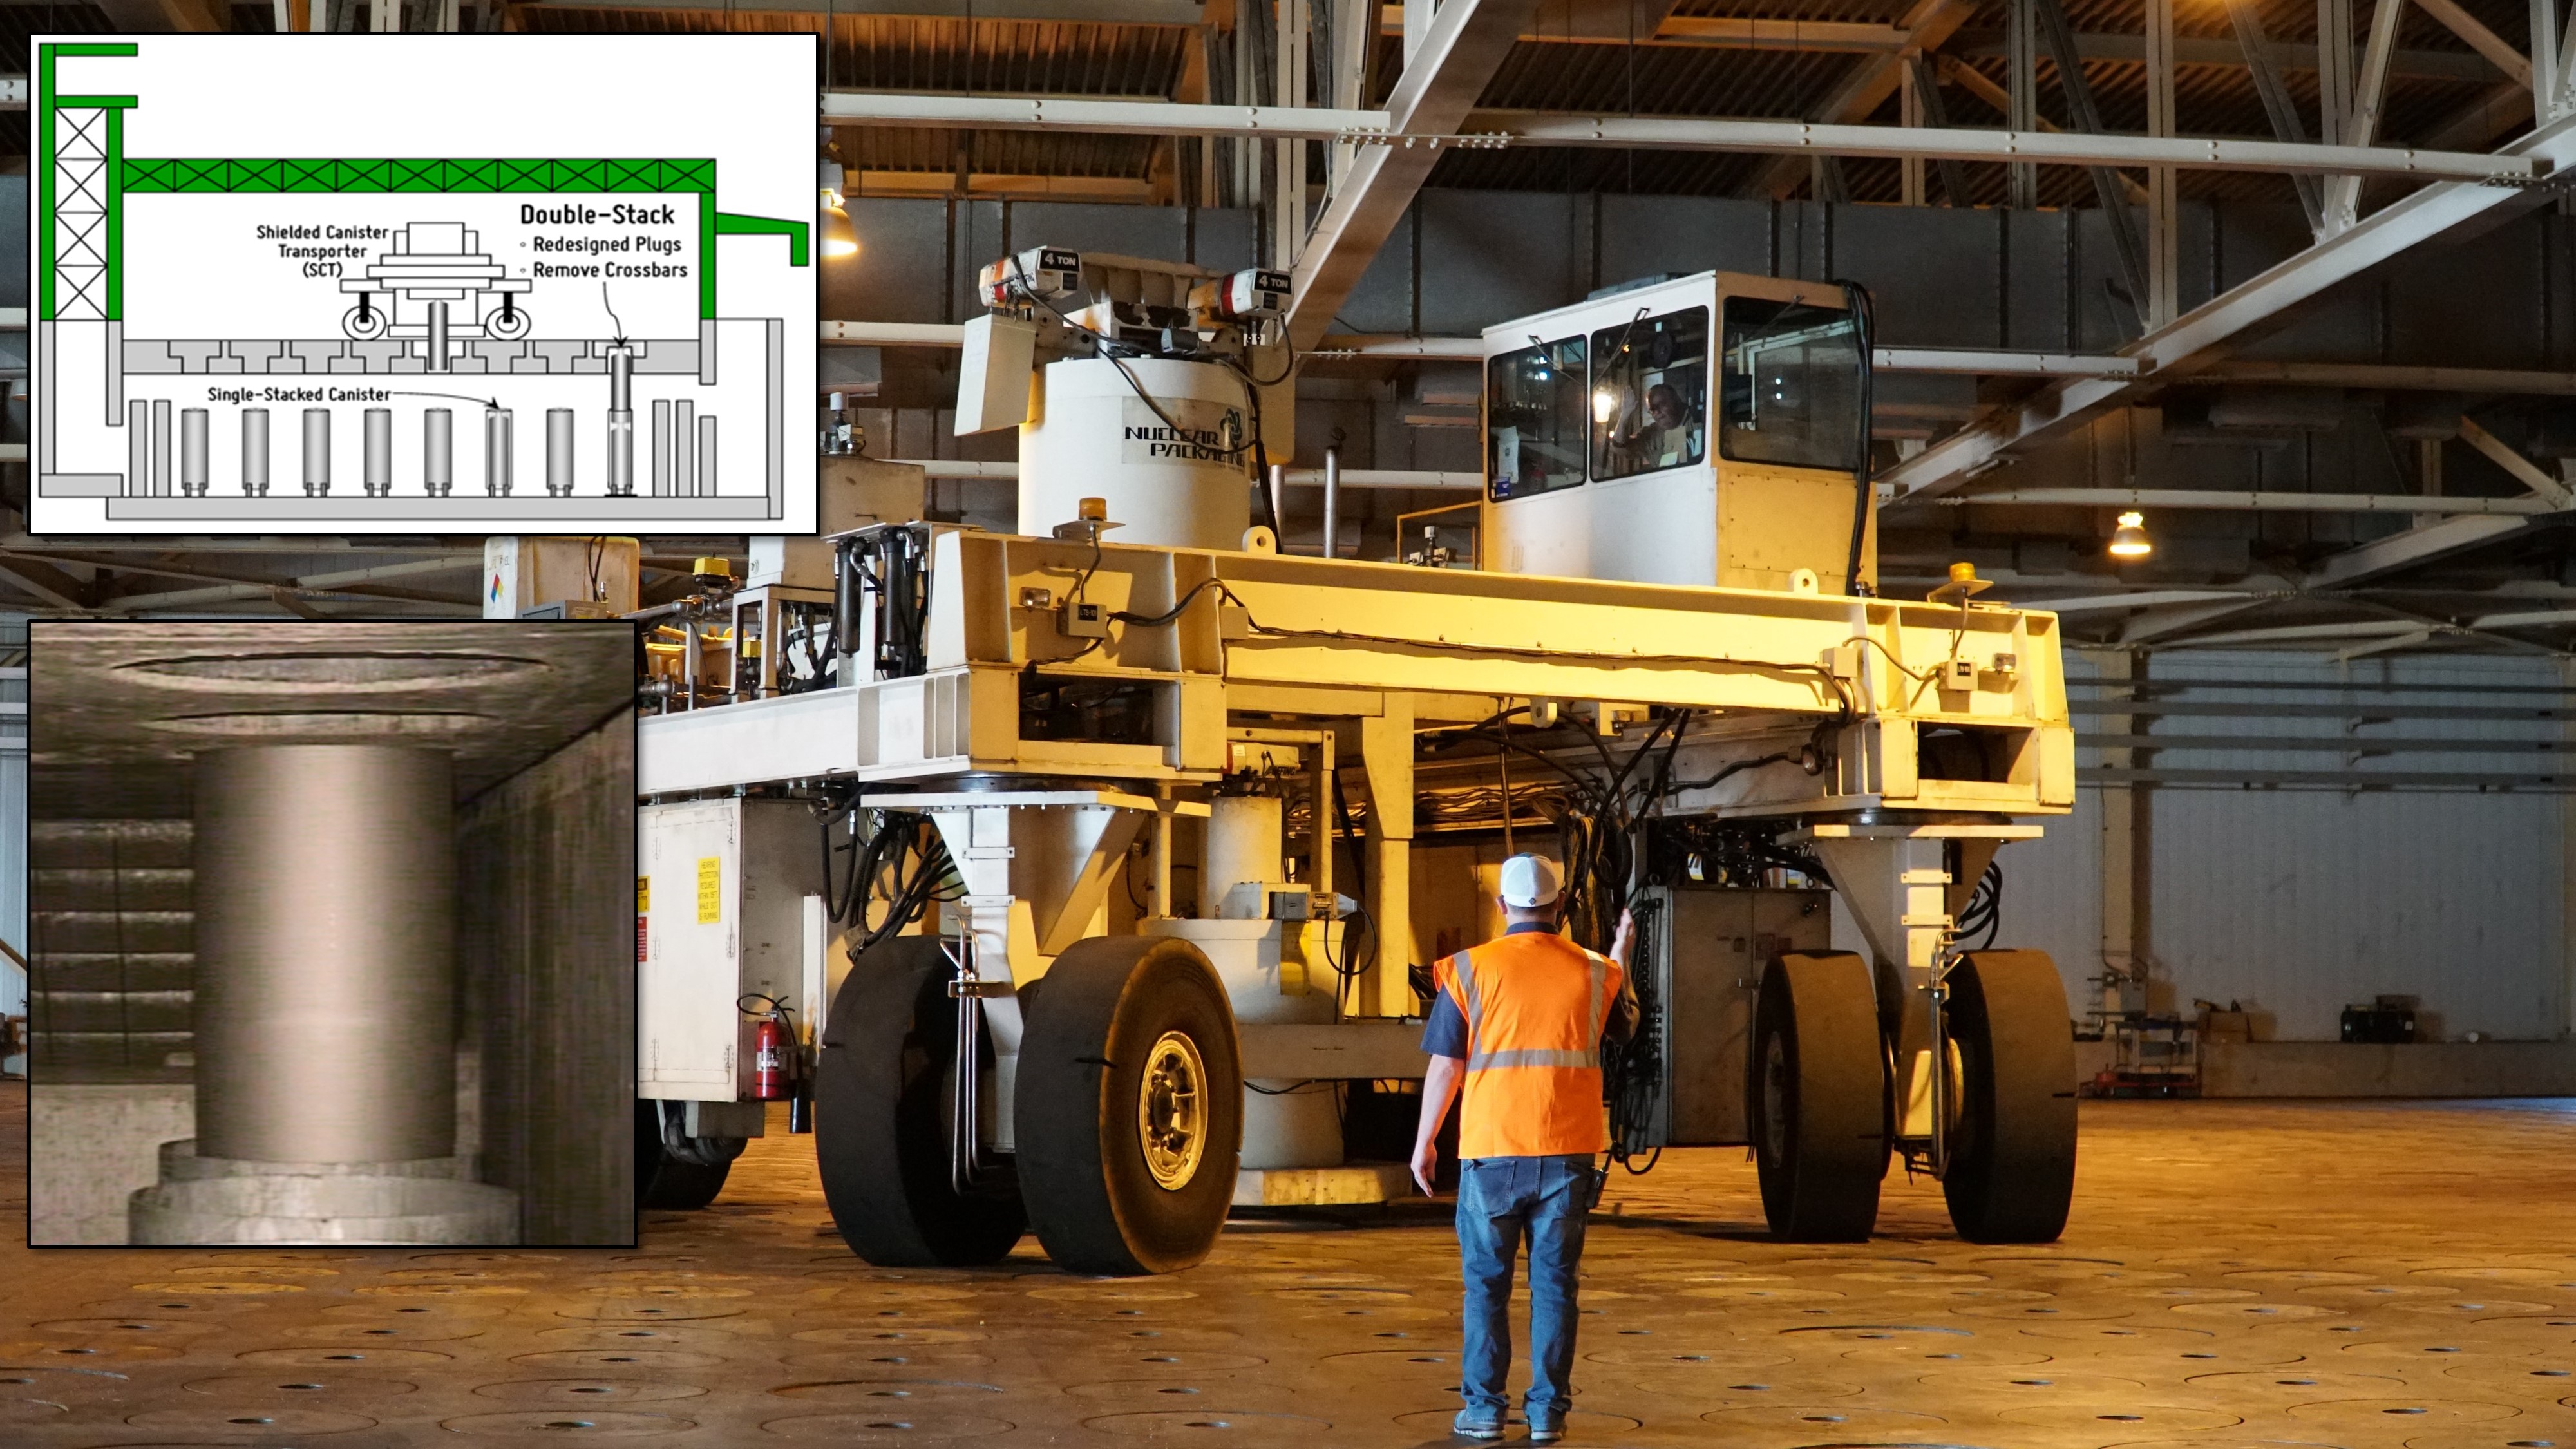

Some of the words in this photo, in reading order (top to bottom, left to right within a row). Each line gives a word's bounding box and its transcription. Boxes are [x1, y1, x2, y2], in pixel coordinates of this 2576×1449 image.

[1045, 252, 1055, 265] 4
[1057, 257, 1076, 267] TON
[1258, 274, 1269, 287] 4
[1271, 278, 1289, 289] TON
[1124, 426, 1219, 446] NUCLEAR
